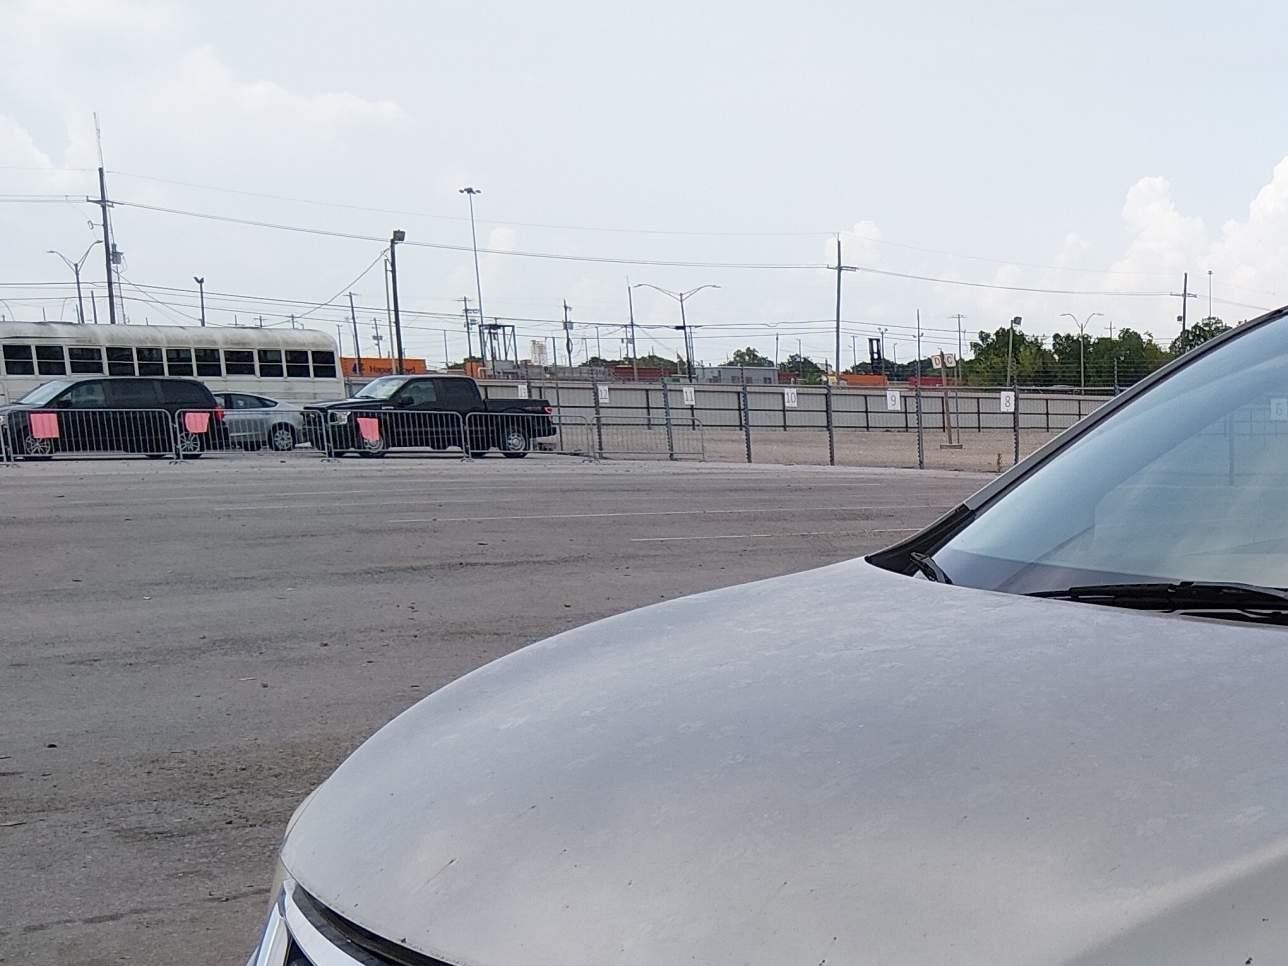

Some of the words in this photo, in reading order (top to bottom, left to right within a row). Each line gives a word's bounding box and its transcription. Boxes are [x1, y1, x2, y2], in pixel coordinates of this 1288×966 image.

[786, 391, 796, 403] 10
[890, 394, 897, 407] 9
[1004, 395, 1011, 408] 8
